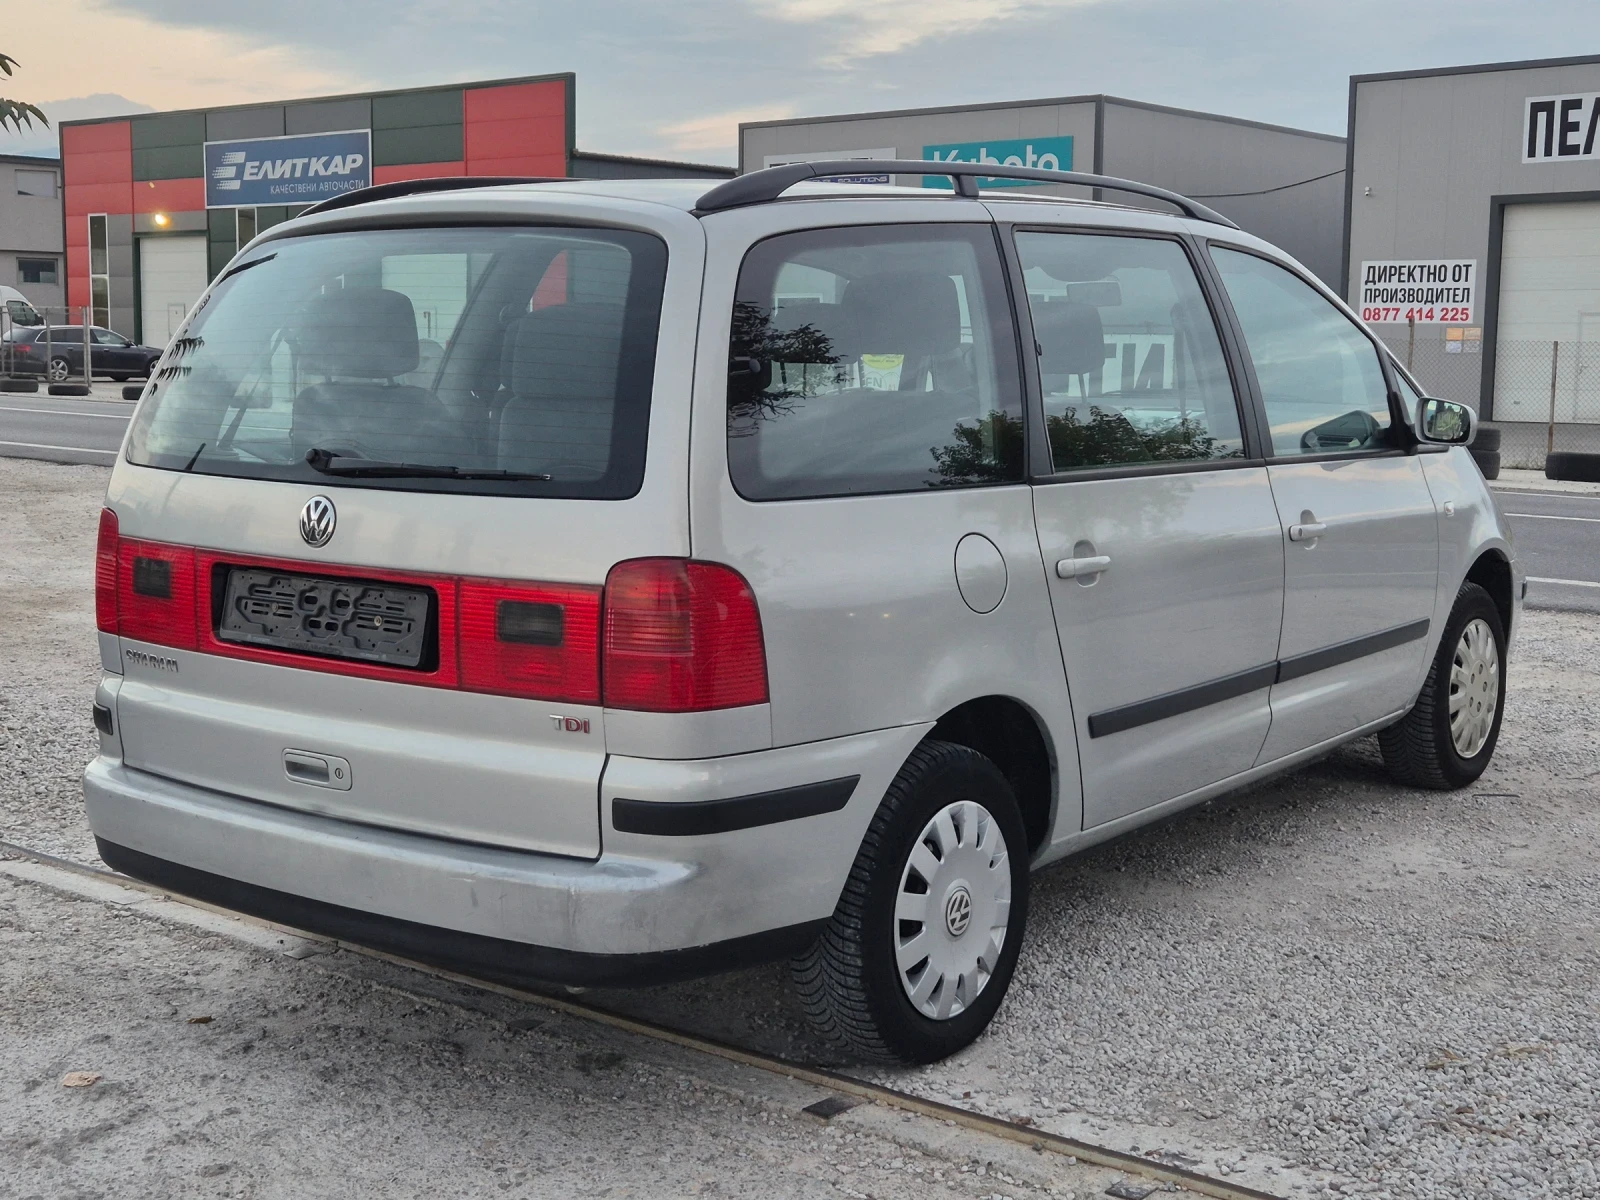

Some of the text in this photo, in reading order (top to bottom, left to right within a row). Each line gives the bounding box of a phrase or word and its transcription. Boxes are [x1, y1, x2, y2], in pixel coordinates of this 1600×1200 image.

[270, 179, 365, 195] КАЧЕСТВЕНИ АВТОЧАСТИ
[1365, 264, 1472, 285] ДИРЕКТНО ОТ
[1364, 288, 1470, 304] ПРОИЗВОДИТЕЛ
[1363, 307, 1469, 321] 0877 414 225
[549, 714, 590, 734] TDI
